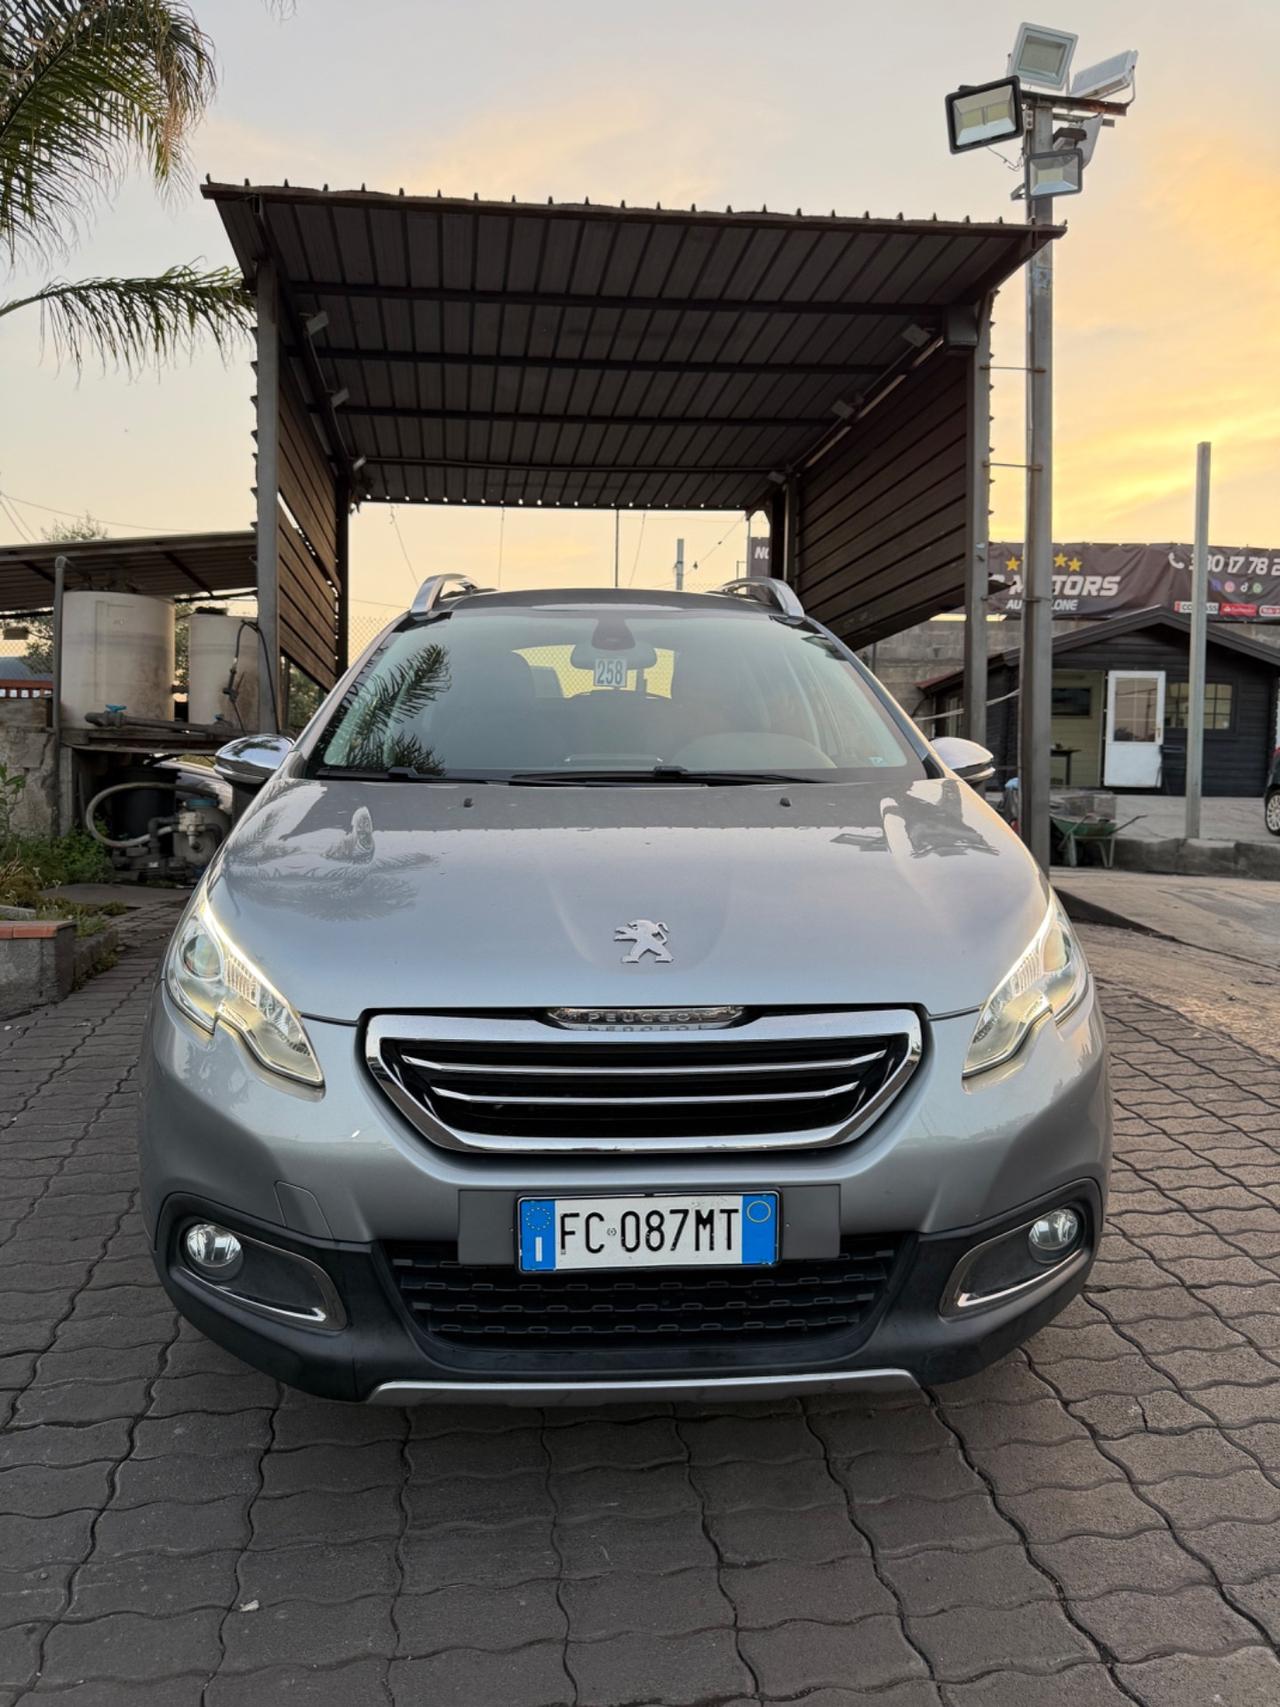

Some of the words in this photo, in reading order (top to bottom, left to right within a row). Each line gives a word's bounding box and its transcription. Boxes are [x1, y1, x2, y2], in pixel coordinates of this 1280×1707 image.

[1248, 557, 1269, 576] 78
[597, 660, 623, 685] 258
[560, 1212, 605, 1254] FC
[620, 1208, 740, 1253] 087MT
